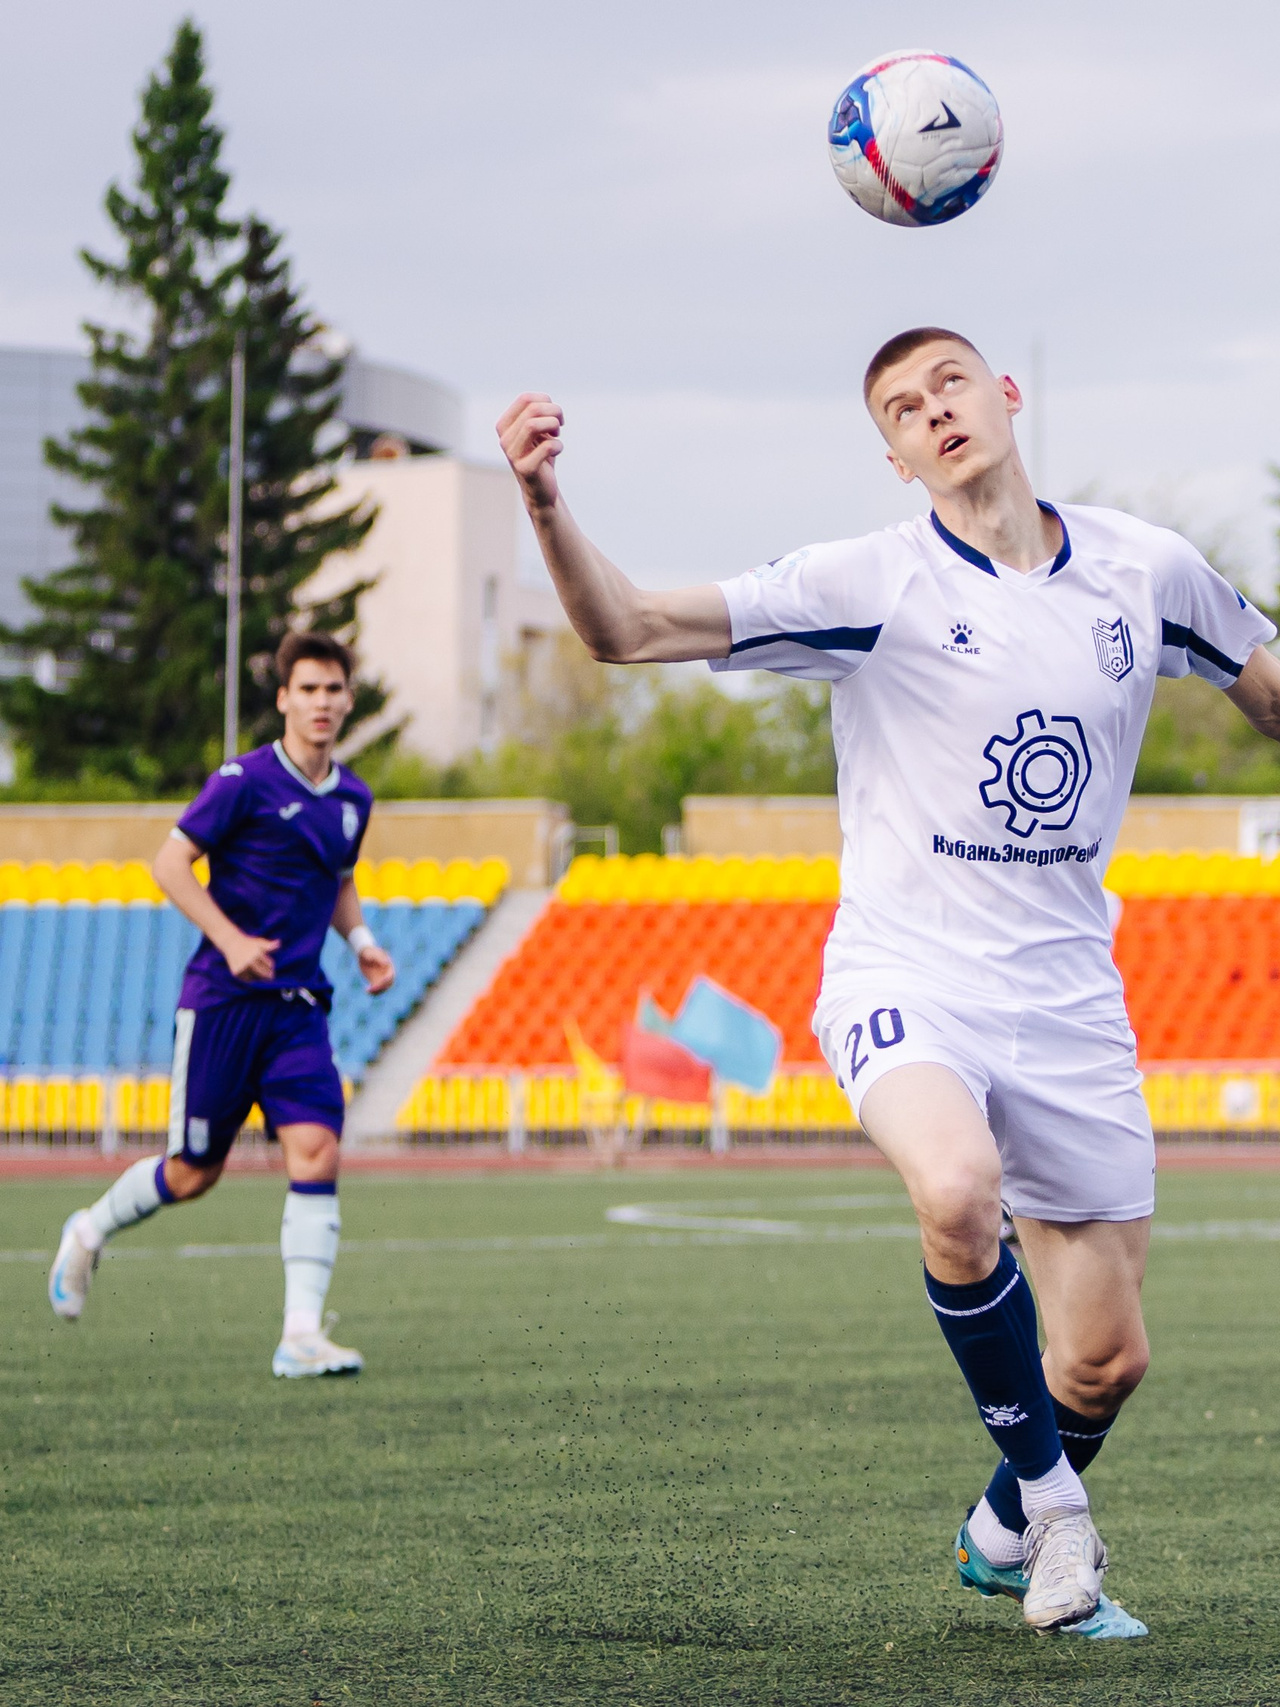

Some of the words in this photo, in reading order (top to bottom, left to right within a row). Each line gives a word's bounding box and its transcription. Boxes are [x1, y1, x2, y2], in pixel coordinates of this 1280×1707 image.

[941, 643, 981, 655] KELME
[844, 1007, 905, 1082] 20
[985, 1412, 1029, 1427] KELME
